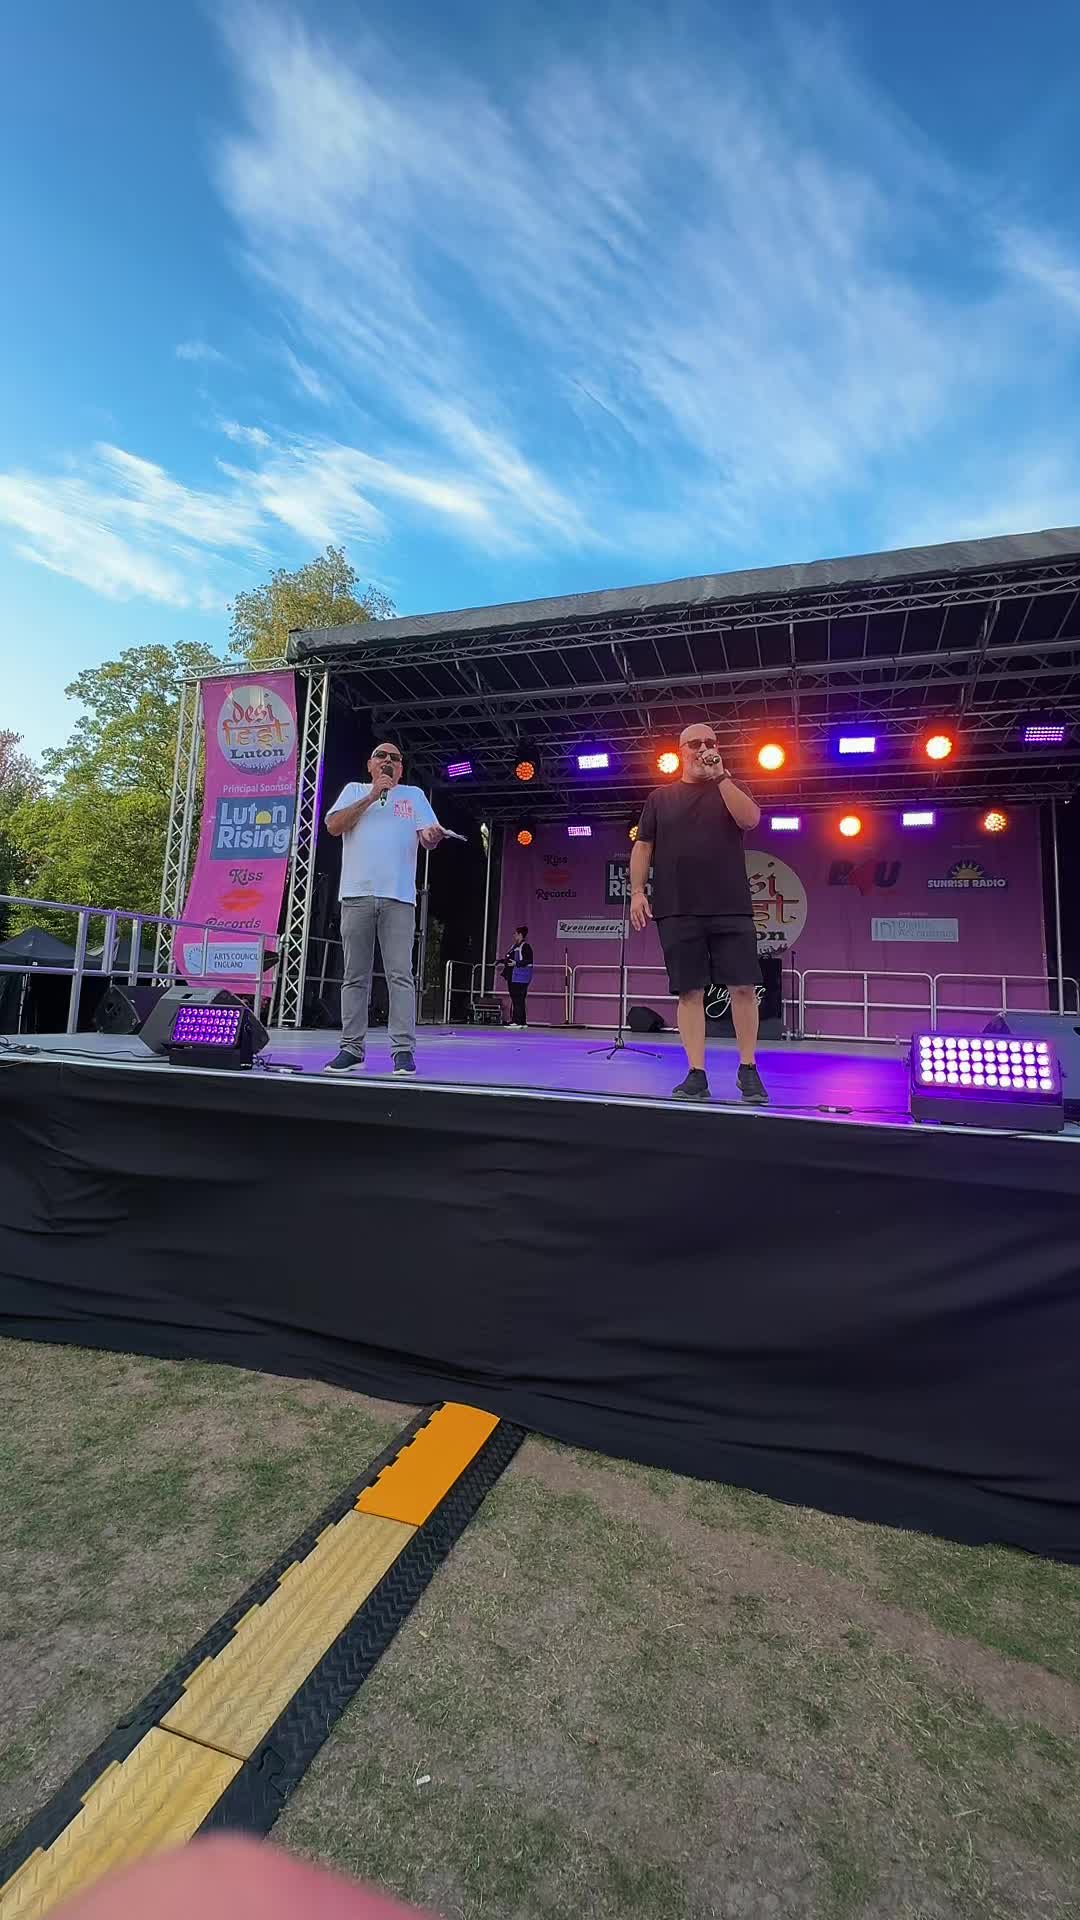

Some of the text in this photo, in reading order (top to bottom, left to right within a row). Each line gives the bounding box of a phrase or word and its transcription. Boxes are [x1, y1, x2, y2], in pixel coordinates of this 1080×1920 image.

[230, 748, 285, 759] Luton
[223, 783, 292, 793] Principal Sponsor
[220, 802, 287, 825] Luton
[216, 825, 291, 854] Rising
[229, 868, 263, 885] Kiss
[927, 879, 1006, 888] SUNRISE RADIO
[535, 888, 577, 900] Records
[214, 952, 231, 961] ARTS
[214, 961, 243, 969] ENGLAND
